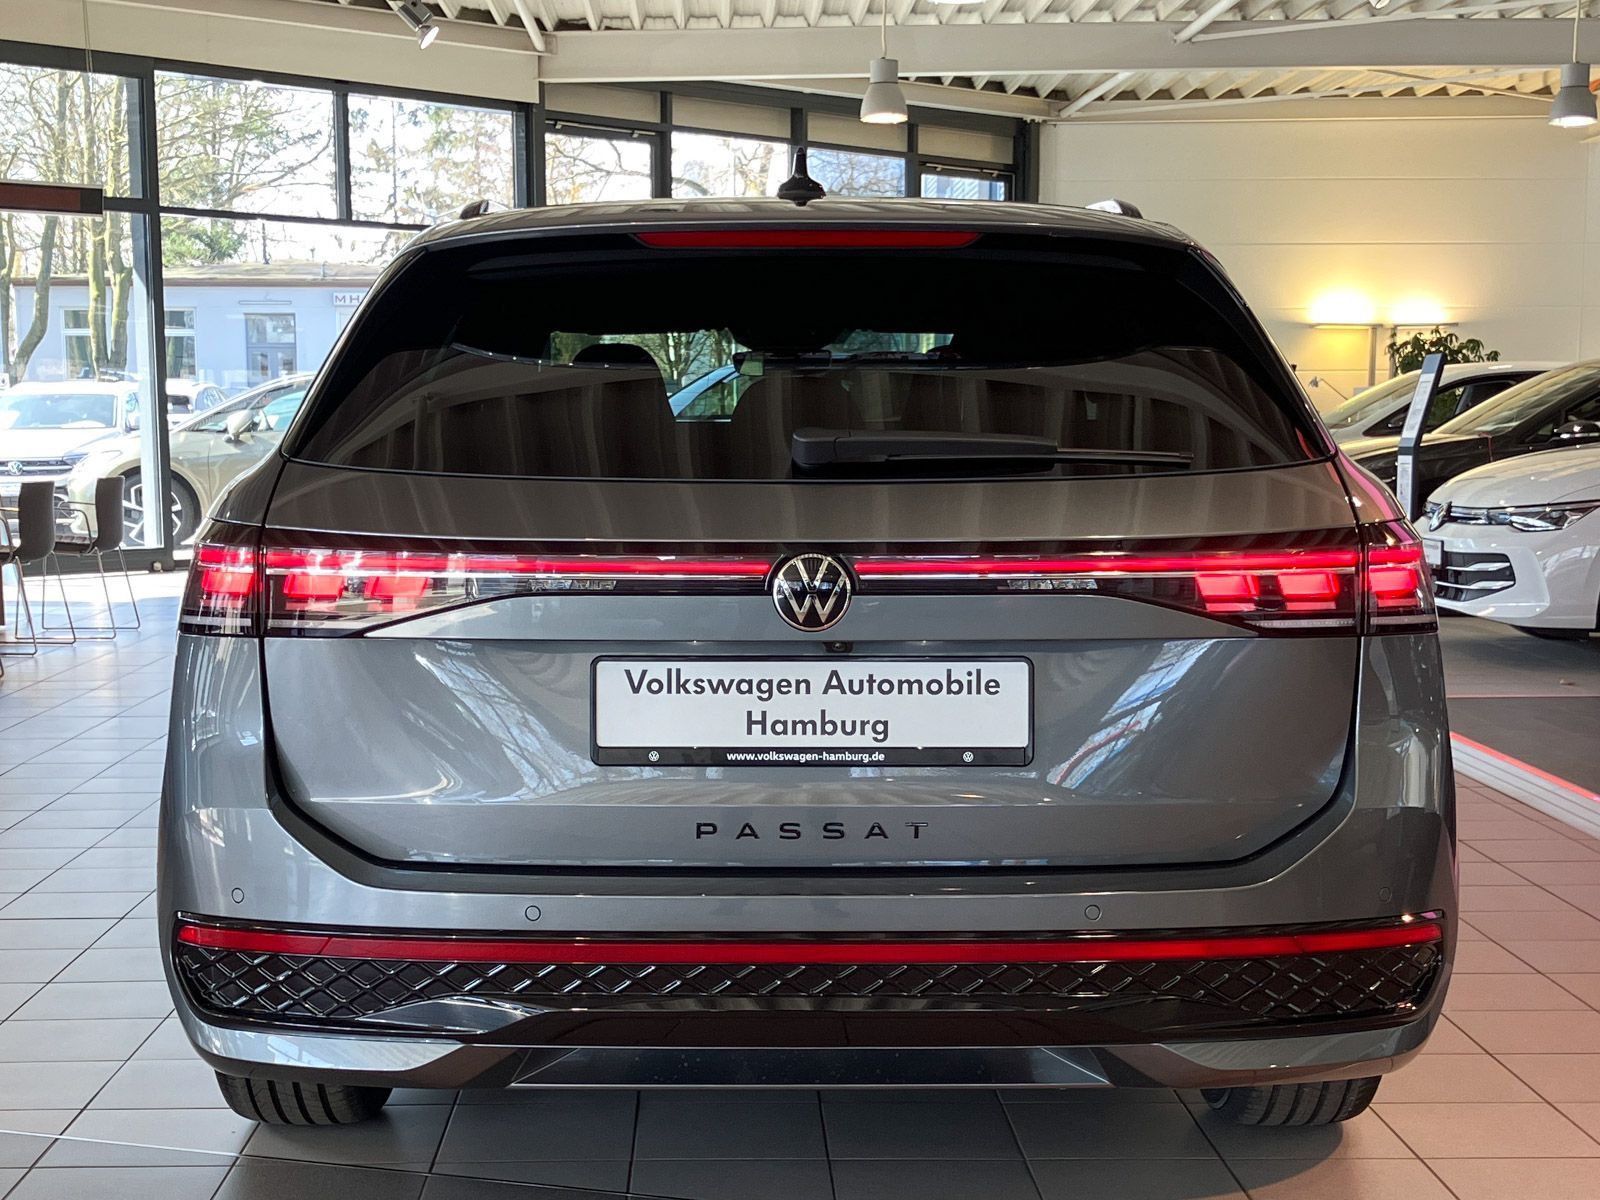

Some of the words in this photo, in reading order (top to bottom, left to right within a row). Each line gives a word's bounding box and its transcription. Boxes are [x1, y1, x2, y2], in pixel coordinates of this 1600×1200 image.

[624, 668, 811, 701] Volkswagen
[822, 669, 1001, 696] Automobile
[746, 710, 890, 743] Hamburg
[726, 751, 886, 764] www.volkswagen-hamburg.de
[695, 822, 930, 840] PASSAT
